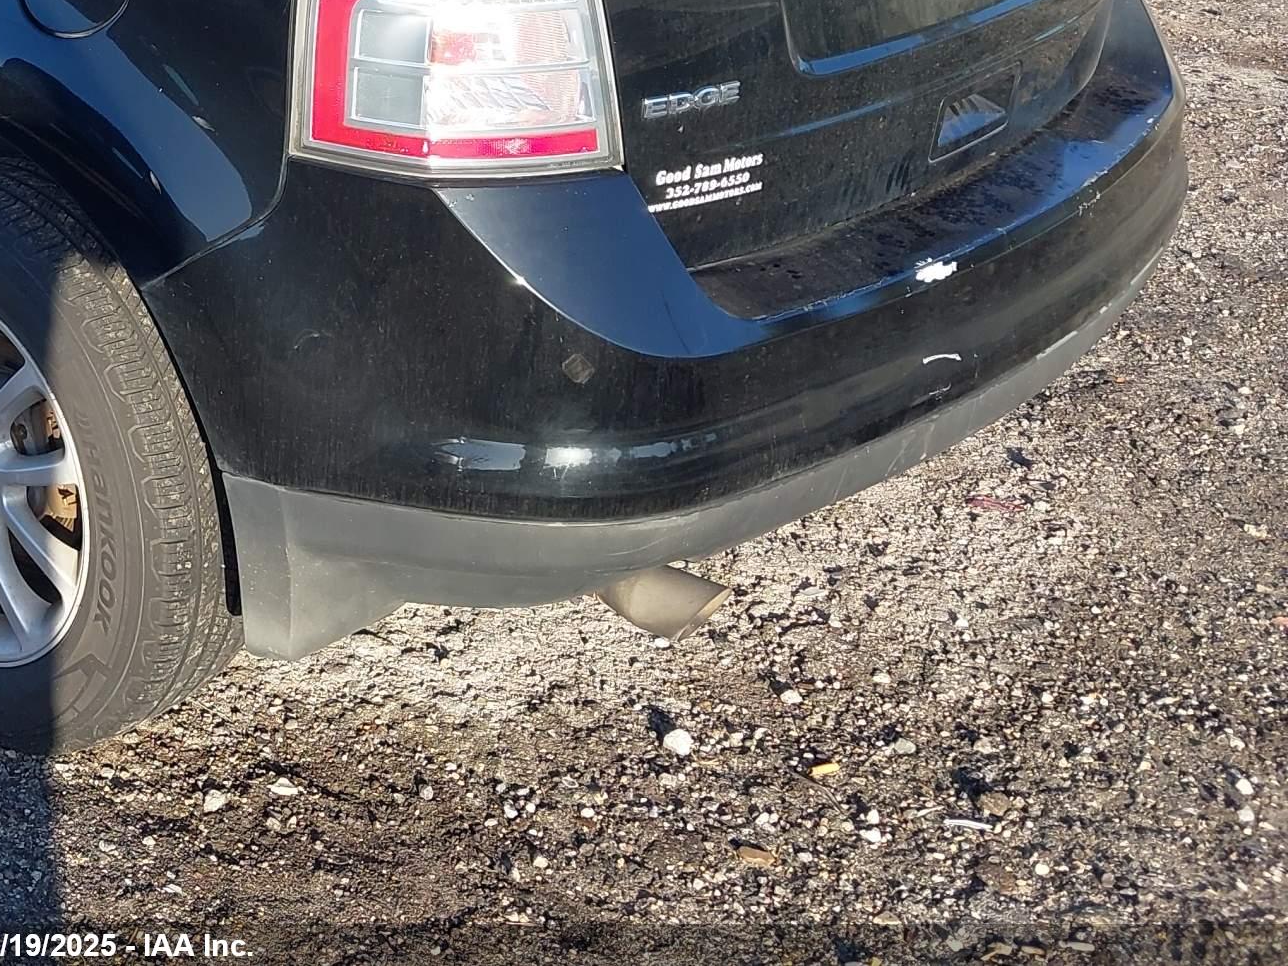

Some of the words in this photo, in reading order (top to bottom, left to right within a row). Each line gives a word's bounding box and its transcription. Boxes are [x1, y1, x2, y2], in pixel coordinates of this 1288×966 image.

[642, 81, 741, 119] EDGE
[656, 166, 692, 186] Good
[693, 162, 722, 179] Sam
[723, 153, 764, 173] Motors
[665, 172, 751, 199] 352-789-6550
